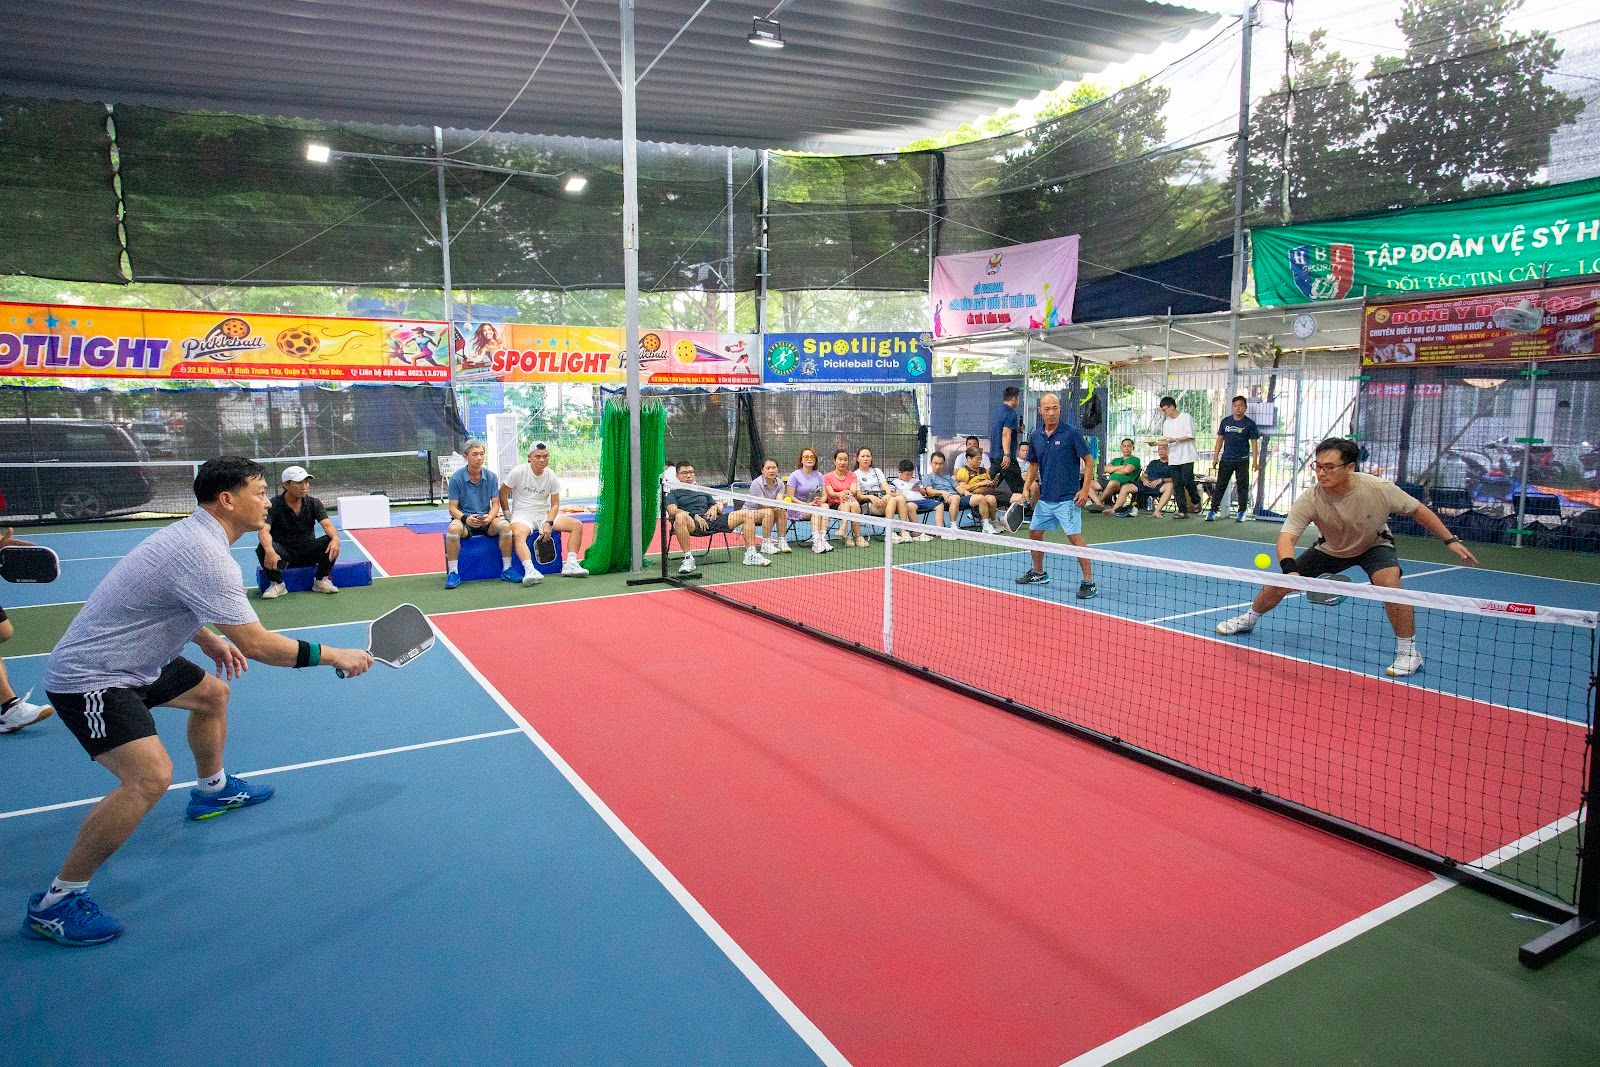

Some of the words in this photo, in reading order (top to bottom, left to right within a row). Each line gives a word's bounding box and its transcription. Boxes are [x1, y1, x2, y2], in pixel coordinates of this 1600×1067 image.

[1365, 243, 1406, 270] TẬP
[1410, 234, 1484, 263] ĐOÀN
[1491, 224, 1526, 256] VỆ
[1532, 219, 1570, 248] SỸ
[1424, 273, 1461, 289] TÁC
[1466, 270, 1502, 286] TIN
[1391, 308, 1449, 324] ĐÔNG
[1455, 306, 1471, 320] Y
[1413, 326, 1425, 335] TRỊ
[1426, 324, 1436, 334] CƠ
[1437, 323, 1463, 333] XƯƠNG
[1464, 321, 1485, 331] KHỚP
[182, 335, 266, 359] Pickleball
[803, 337, 918, 357] Spotlight
[492, 350, 611, 374] SPOTLIGHT
[823, 359, 873, 368] Pickleball
[875, 359, 900, 368] Club
[1508, 604, 1532, 613] Sport
